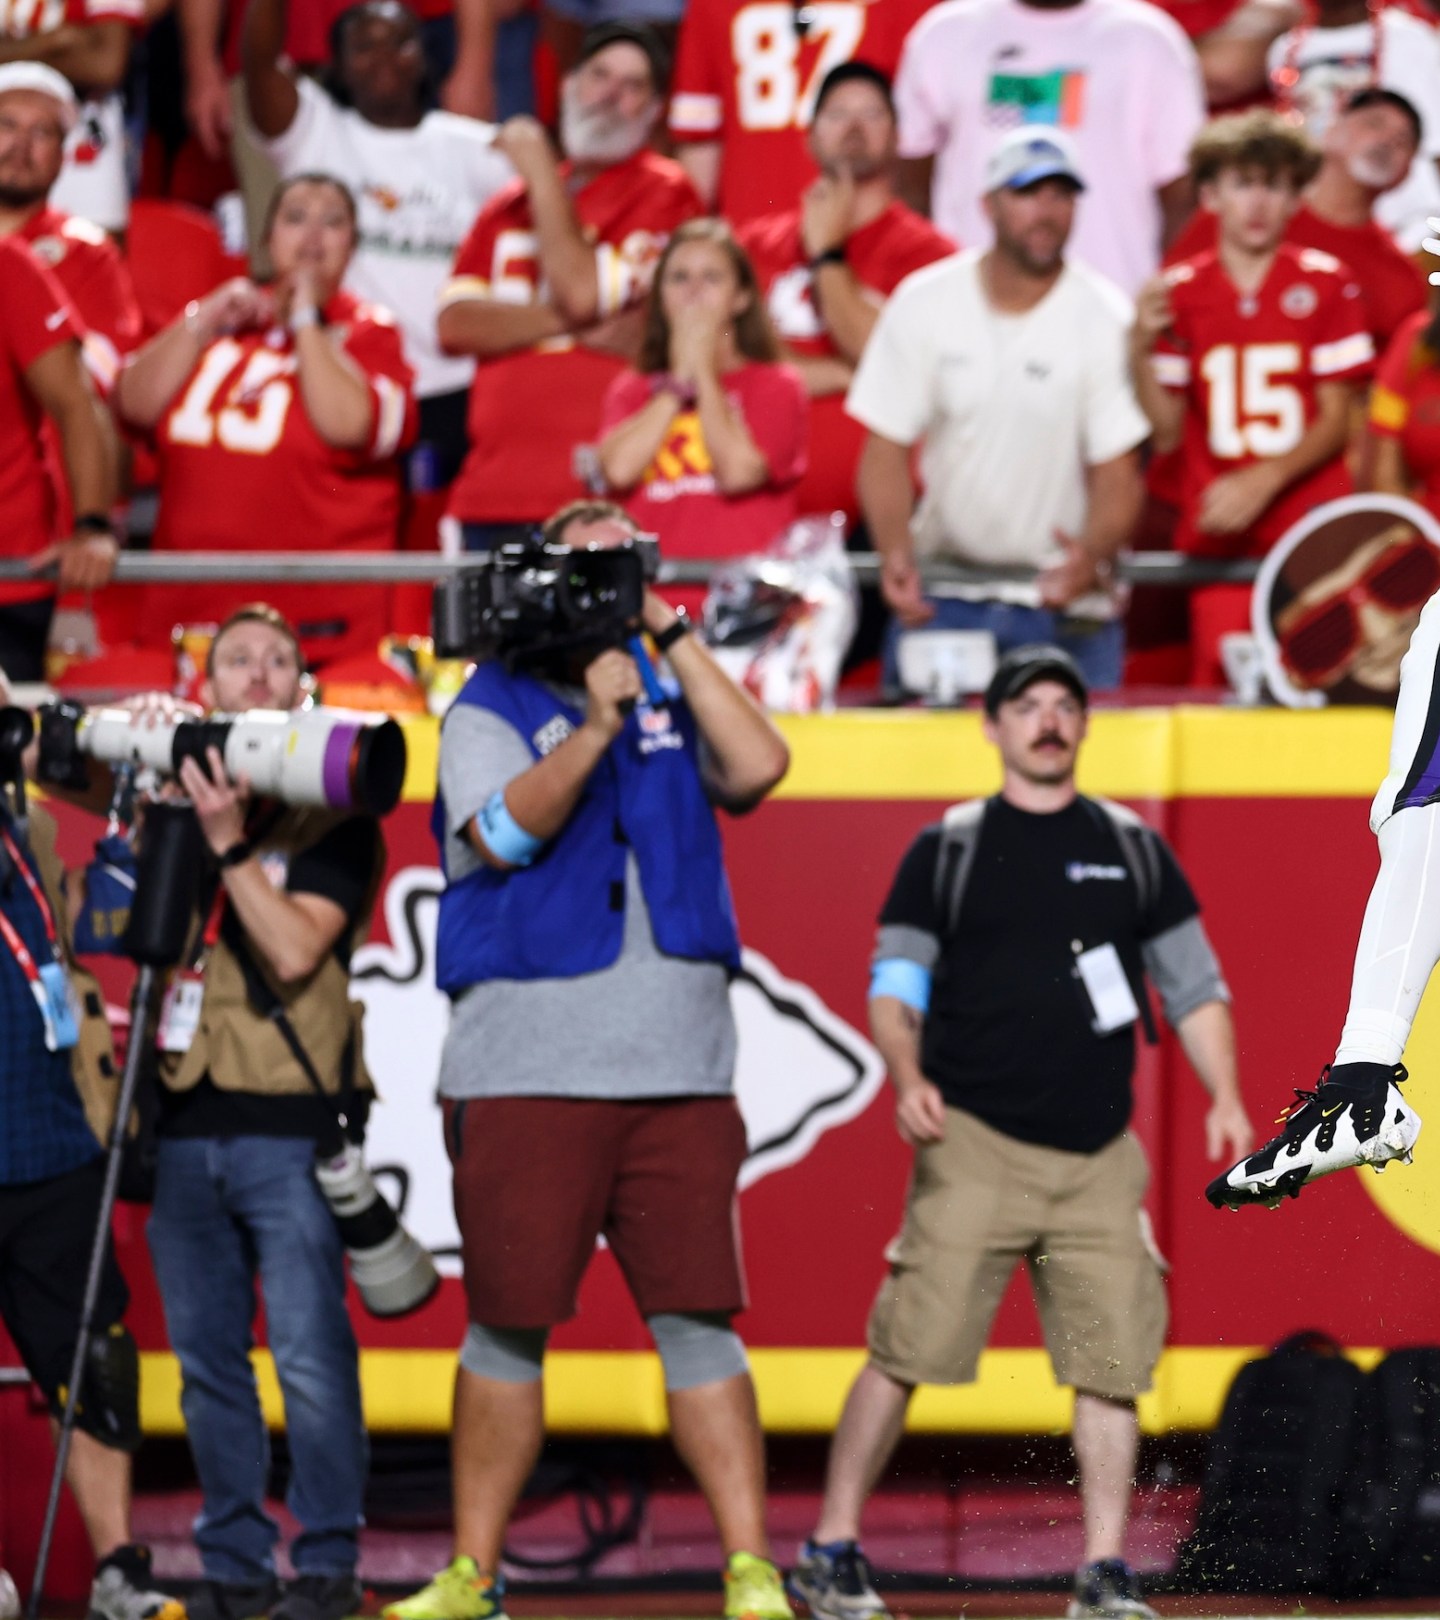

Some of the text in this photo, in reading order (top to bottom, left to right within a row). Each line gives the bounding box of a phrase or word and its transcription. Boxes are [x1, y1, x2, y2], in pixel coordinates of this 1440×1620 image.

[730, 3, 868, 131] 87
[166, 335, 293, 456] 15
[1200, 341, 1305, 461] 15
